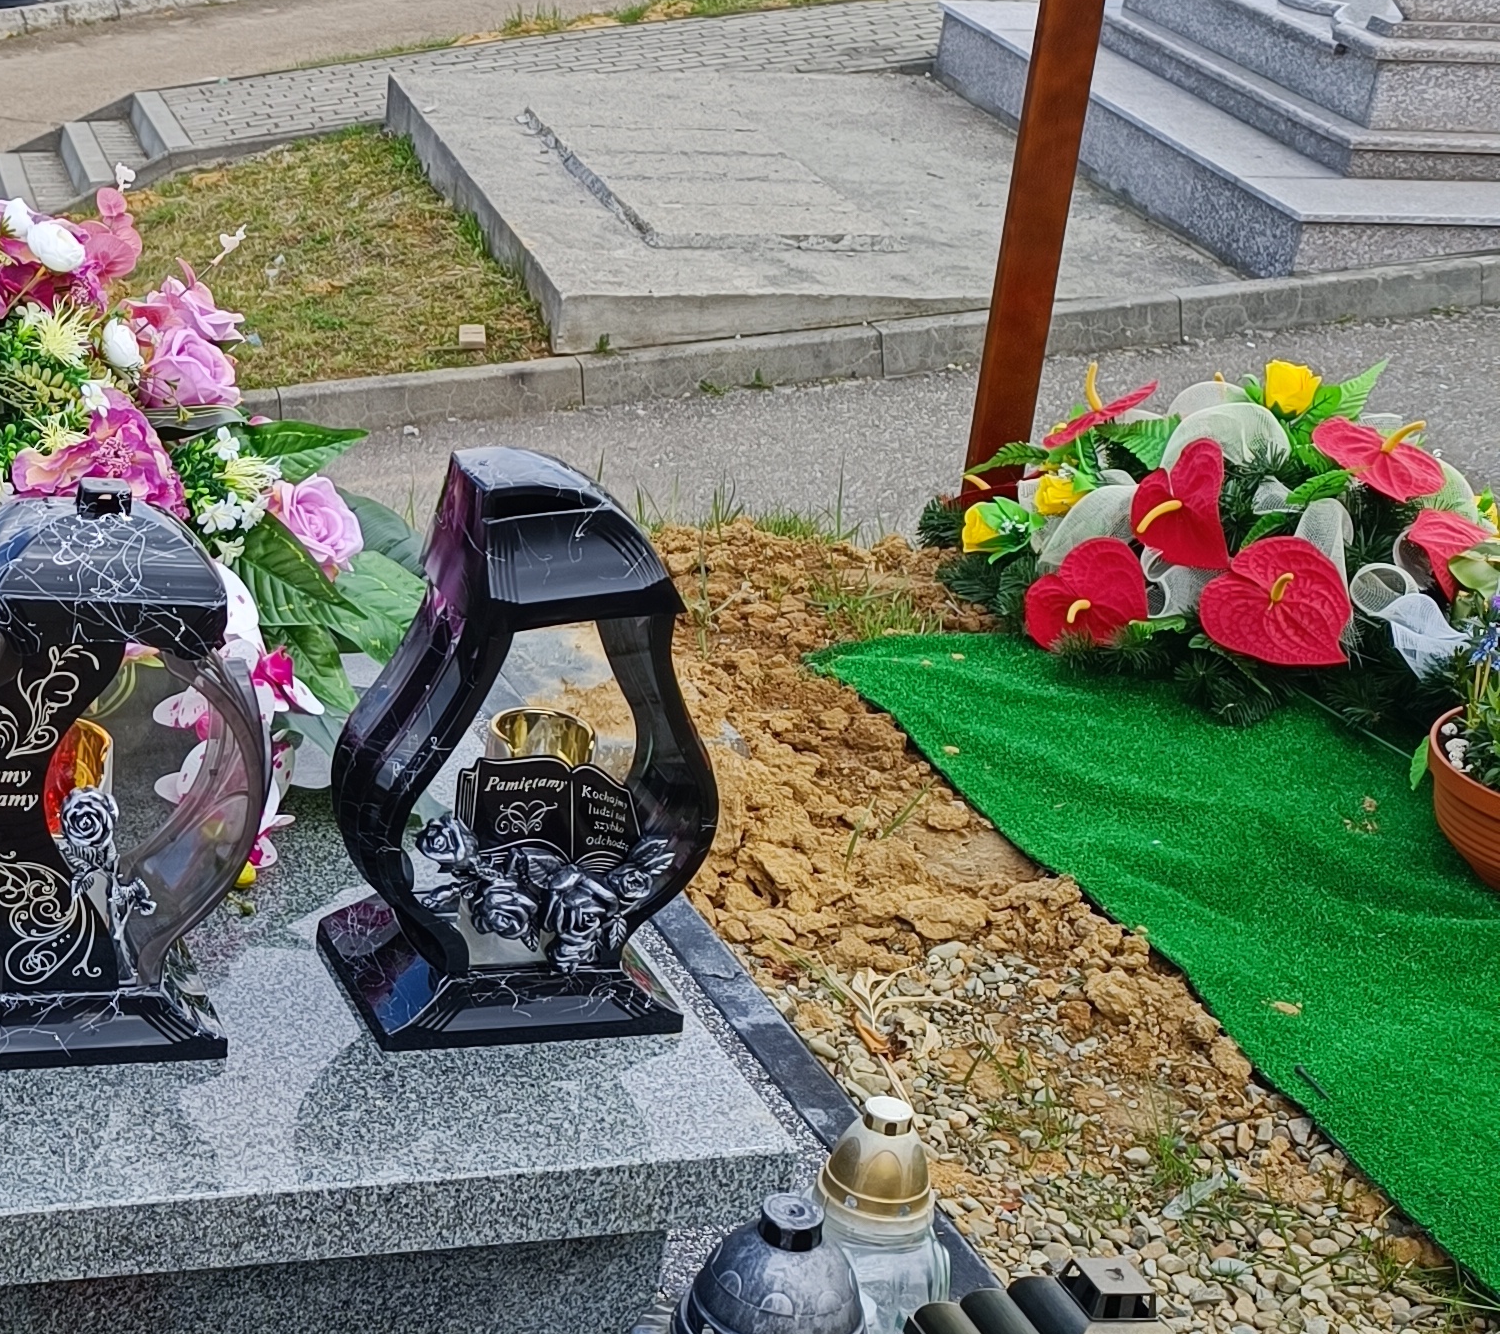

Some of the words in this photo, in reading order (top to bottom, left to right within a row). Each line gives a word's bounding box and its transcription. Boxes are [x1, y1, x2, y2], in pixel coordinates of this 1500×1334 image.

[484, 776, 568, 793] Pamiętamy
[581, 785, 628, 810] Kochajmy
[588, 803, 614, 820] ludzi
[593, 820, 625, 835] szybko
